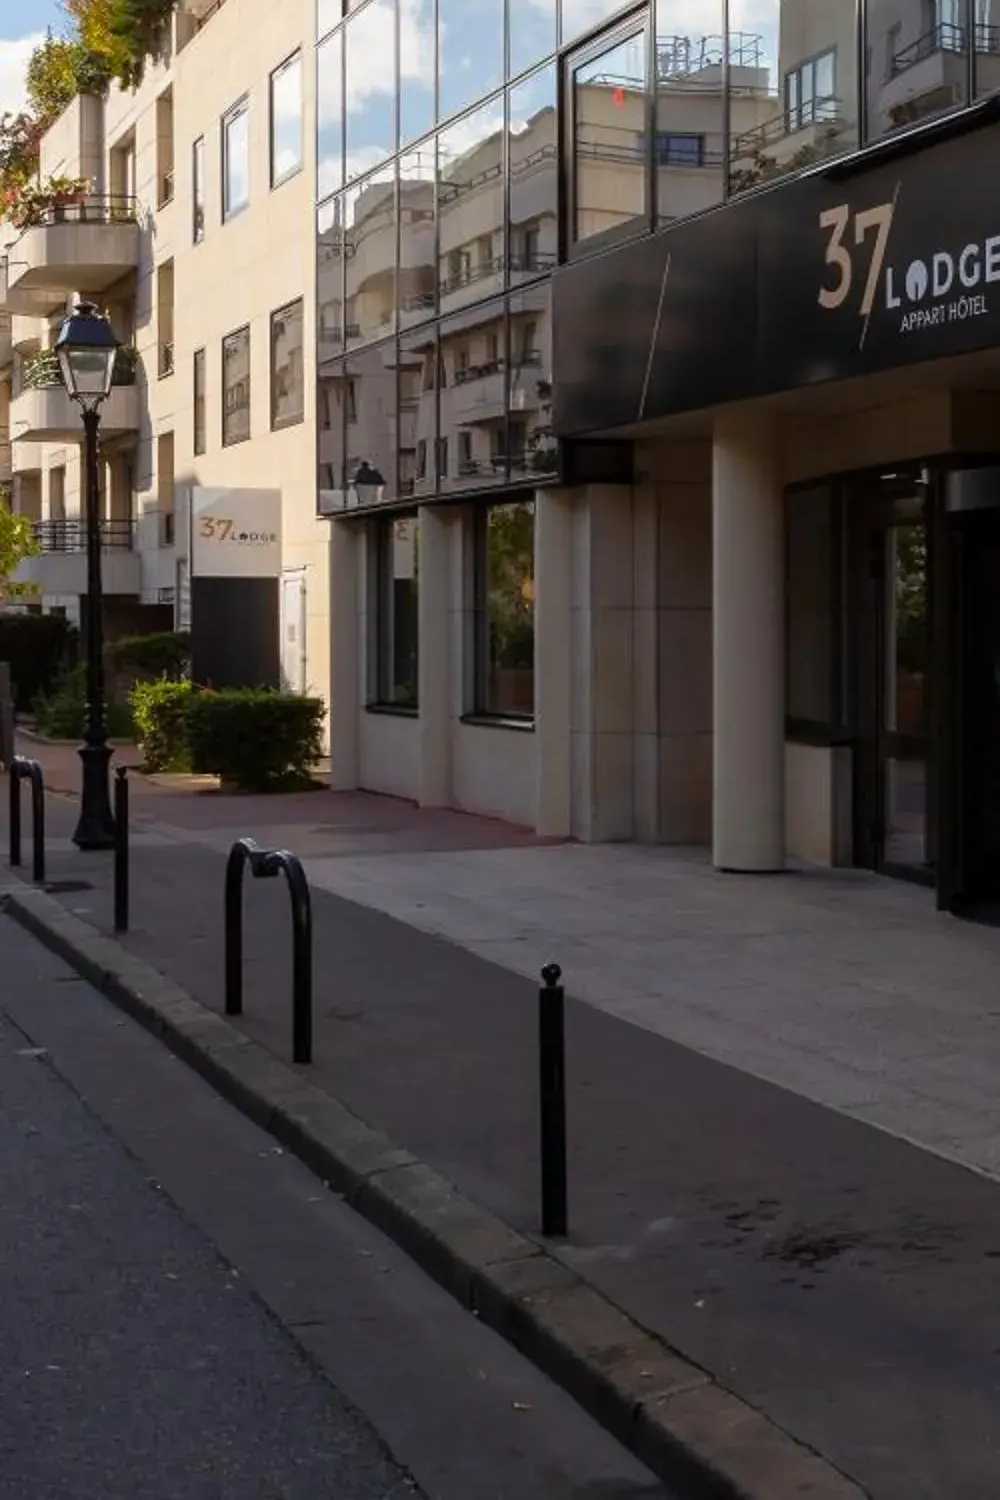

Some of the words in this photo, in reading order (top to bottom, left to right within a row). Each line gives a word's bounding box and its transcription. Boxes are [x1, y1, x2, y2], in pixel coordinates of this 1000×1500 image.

[818, 203, 895, 316] 37
[900, 304, 945, 333] APPART
[947, 294, 988, 321] HÔTEL
[200, 516, 232, 541] 37
